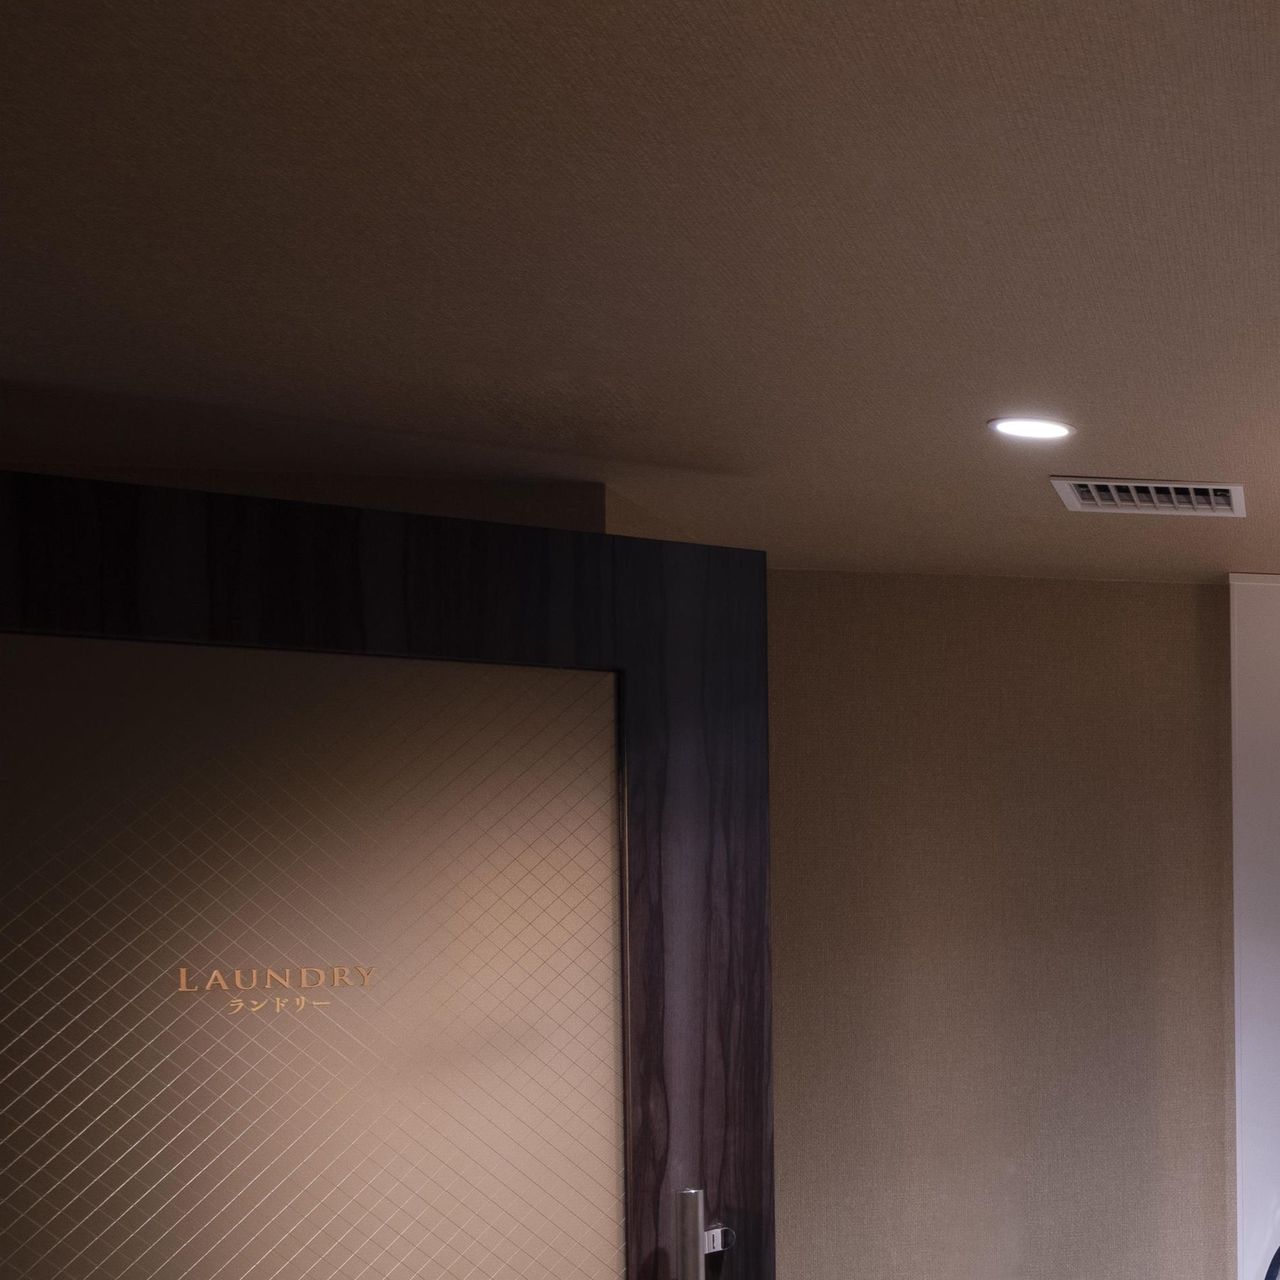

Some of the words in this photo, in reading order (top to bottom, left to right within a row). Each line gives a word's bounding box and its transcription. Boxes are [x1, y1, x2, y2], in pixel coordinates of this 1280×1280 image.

[178, 965, 376, 992] LAUNDRY
[229, 996, 332, 1015] ランドリー
